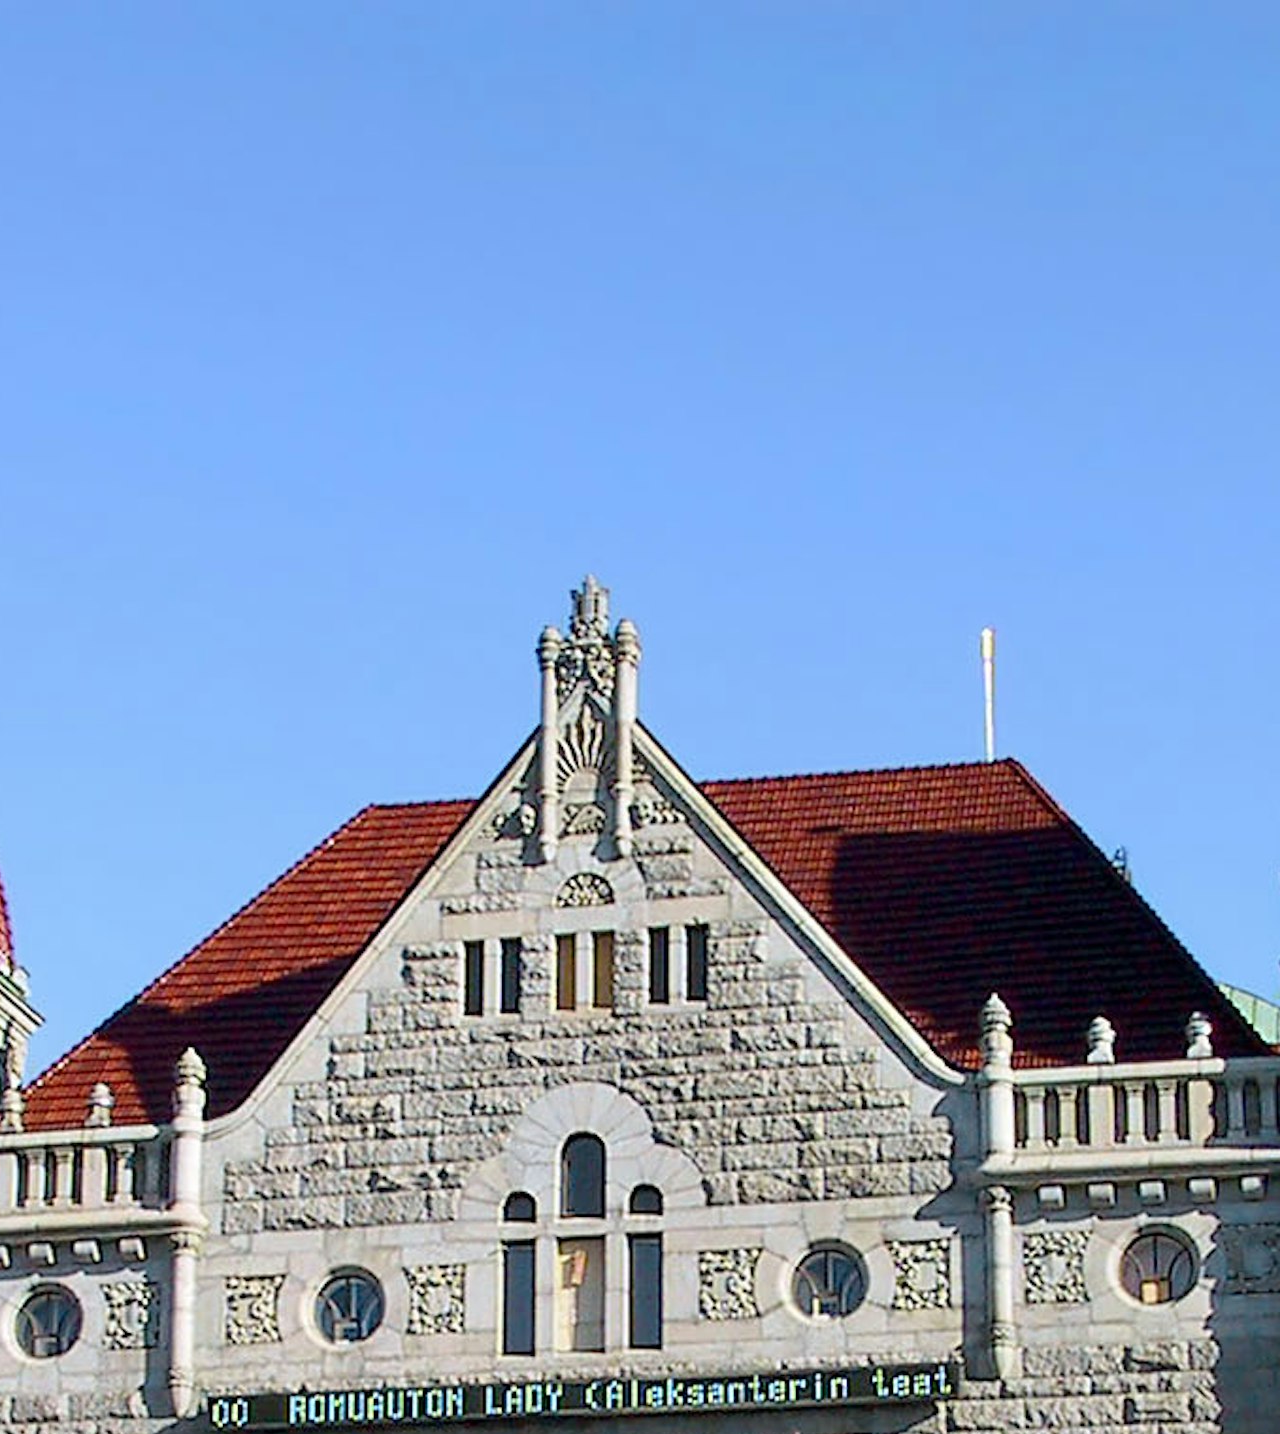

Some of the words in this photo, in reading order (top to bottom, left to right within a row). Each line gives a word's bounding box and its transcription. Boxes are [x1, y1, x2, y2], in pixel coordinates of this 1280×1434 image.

[289, 1387, 463, 1424] ROMUAUTON
[485, 1383, 563, 1416] LADY
[584, 1373, 848, 1410] (Aleksanterin
[872, 1366, 951, 1397] teat
